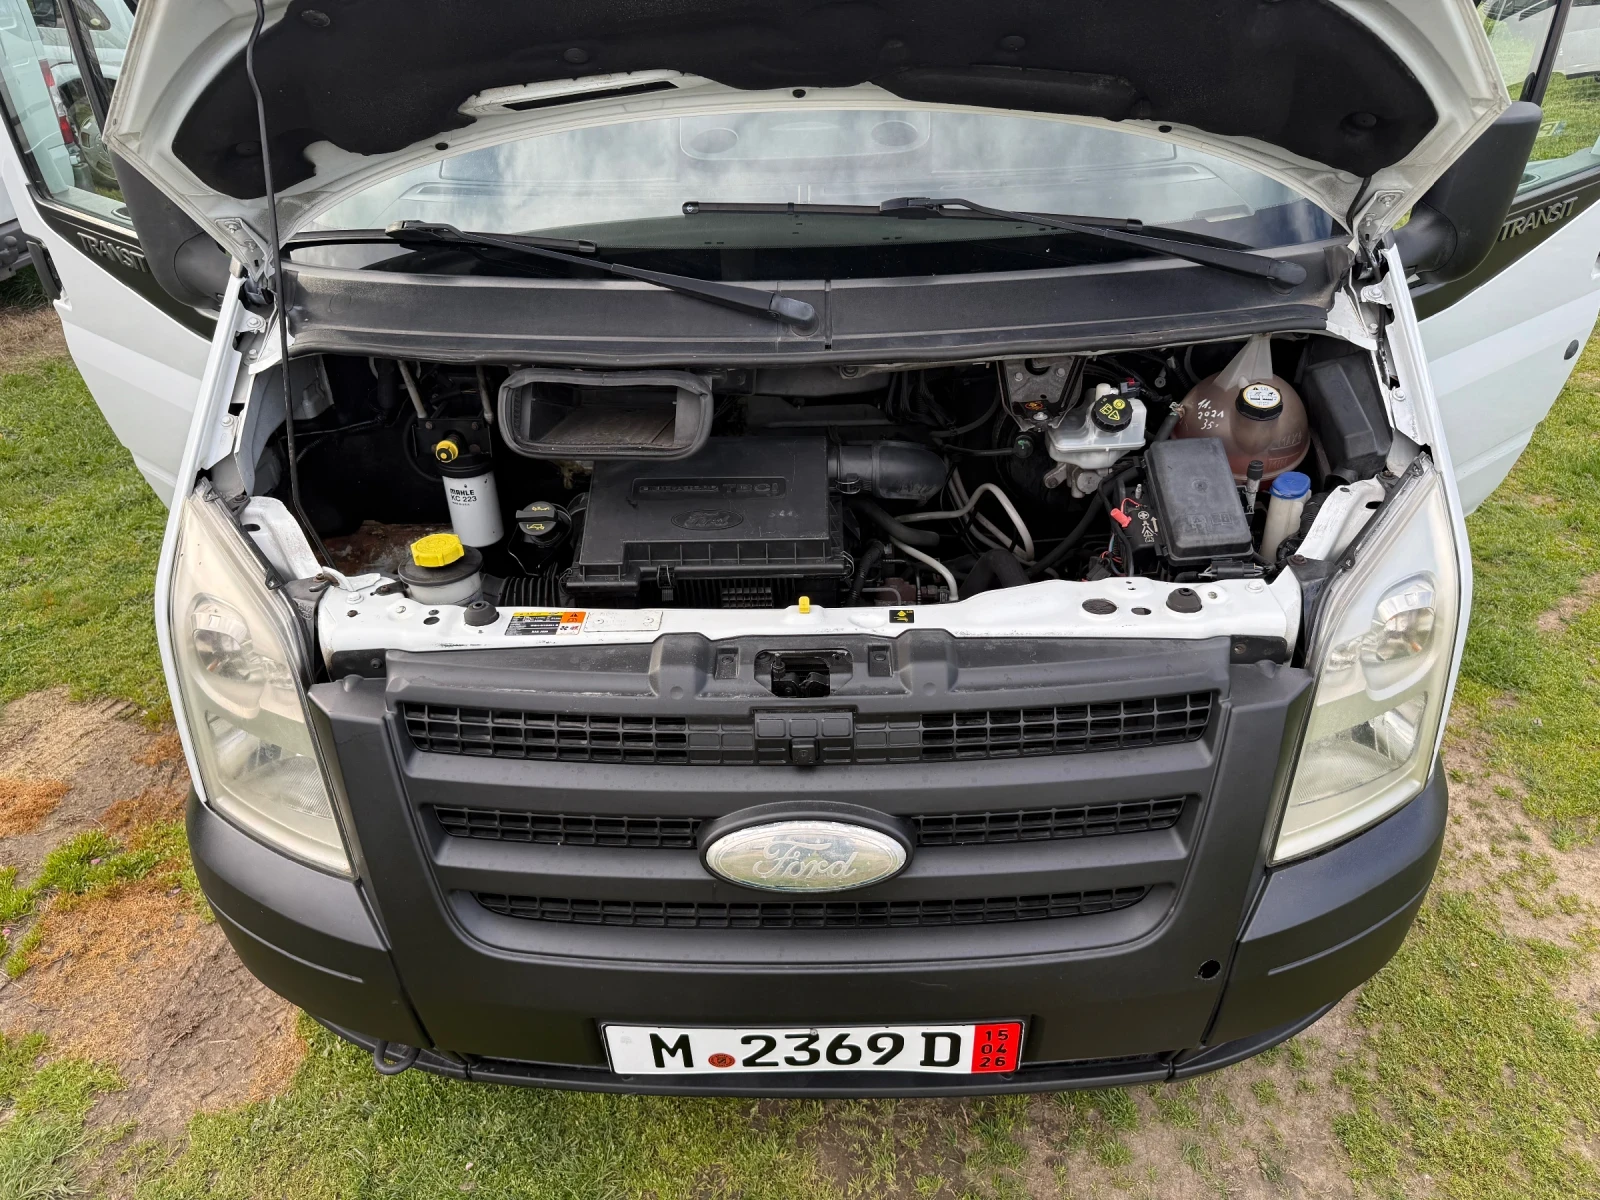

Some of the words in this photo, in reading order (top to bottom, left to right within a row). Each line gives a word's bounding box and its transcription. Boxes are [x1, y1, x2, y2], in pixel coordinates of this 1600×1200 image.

[1501, 196, 1579, 241] TRANSIT
[77, 231, 148, 273] TRANSIT
[1197, 409, 1225, 420] 2021
[449, 488, 475, 496] MAHLE
[462, 495, 478, 503] 223
[752, 836, 859, 879] Ford
[985, 1029, 1009, 1041] 15
[649, 1032, 694, 1068] M
[740, 1032, 905, 1067] 2369
[919, 1031, 962, 1067] D
[980, 1043, 1007, 1055] 04
[978, 1056, 1006, 1068] 26
